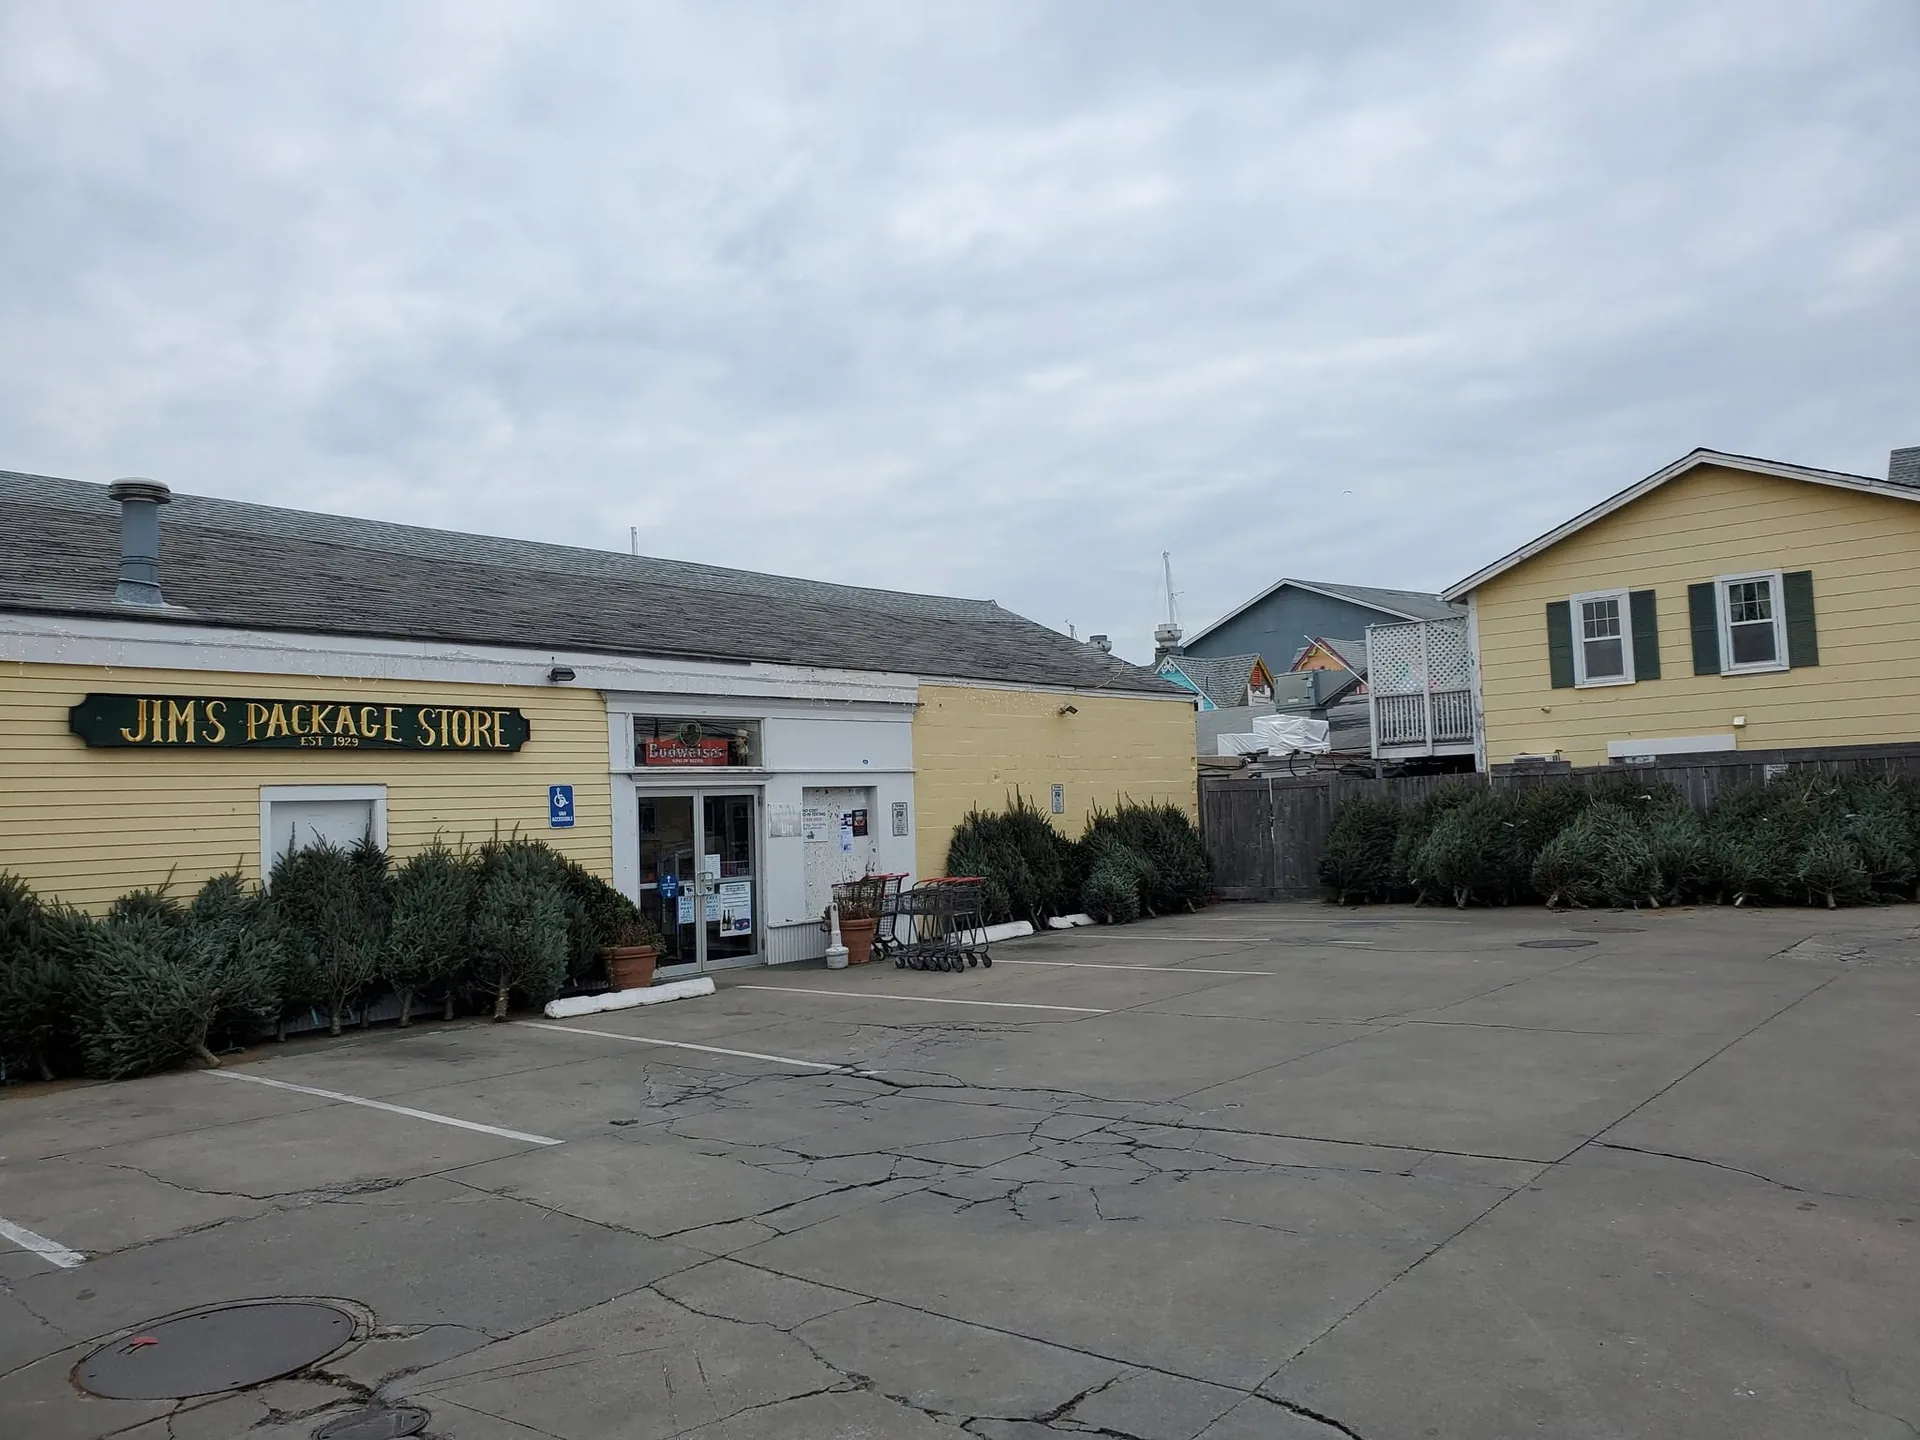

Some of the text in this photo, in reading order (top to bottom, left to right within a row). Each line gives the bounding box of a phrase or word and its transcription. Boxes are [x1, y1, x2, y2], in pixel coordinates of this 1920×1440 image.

[120, 699, 510, 748] JIM'S PACKAGE STORE
[300, 736, 359, 747] EST 1929
[649, 743, 723, 758] Budweiser
